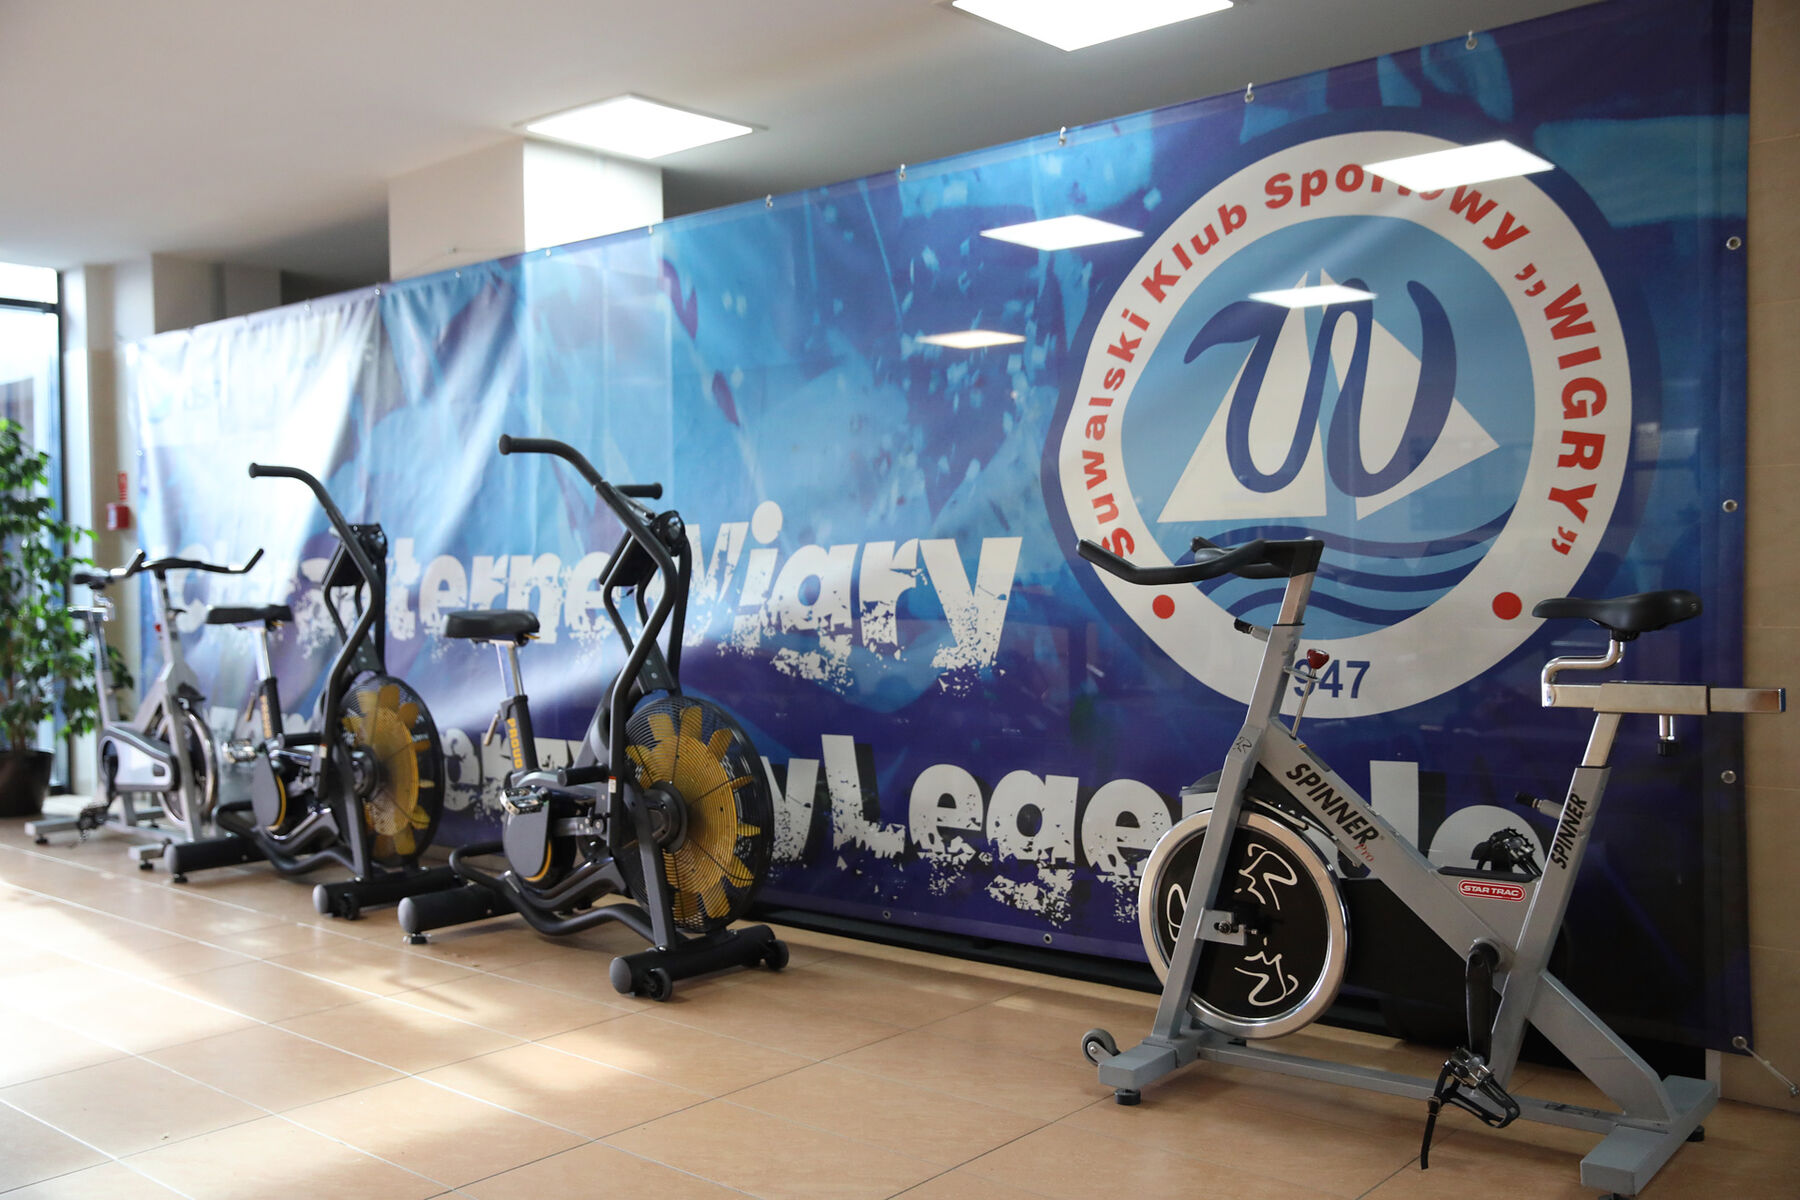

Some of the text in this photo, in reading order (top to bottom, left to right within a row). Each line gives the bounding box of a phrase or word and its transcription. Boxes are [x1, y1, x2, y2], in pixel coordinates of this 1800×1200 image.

[1082, 308, 1151, 558] Suwalski
[1141, 204, 1247, 304] Klub
[1264, 163, 1530, 250] Sporwy
[1293, 658, 1371, 699] 947
[1286, 763, 1379, 845] SPINNER
[1550, 793, 1587, 870] SPINNER
[1355, 842, 1374, 862] Pro
[1463, 885, 1520, 896] STAR TRAC
